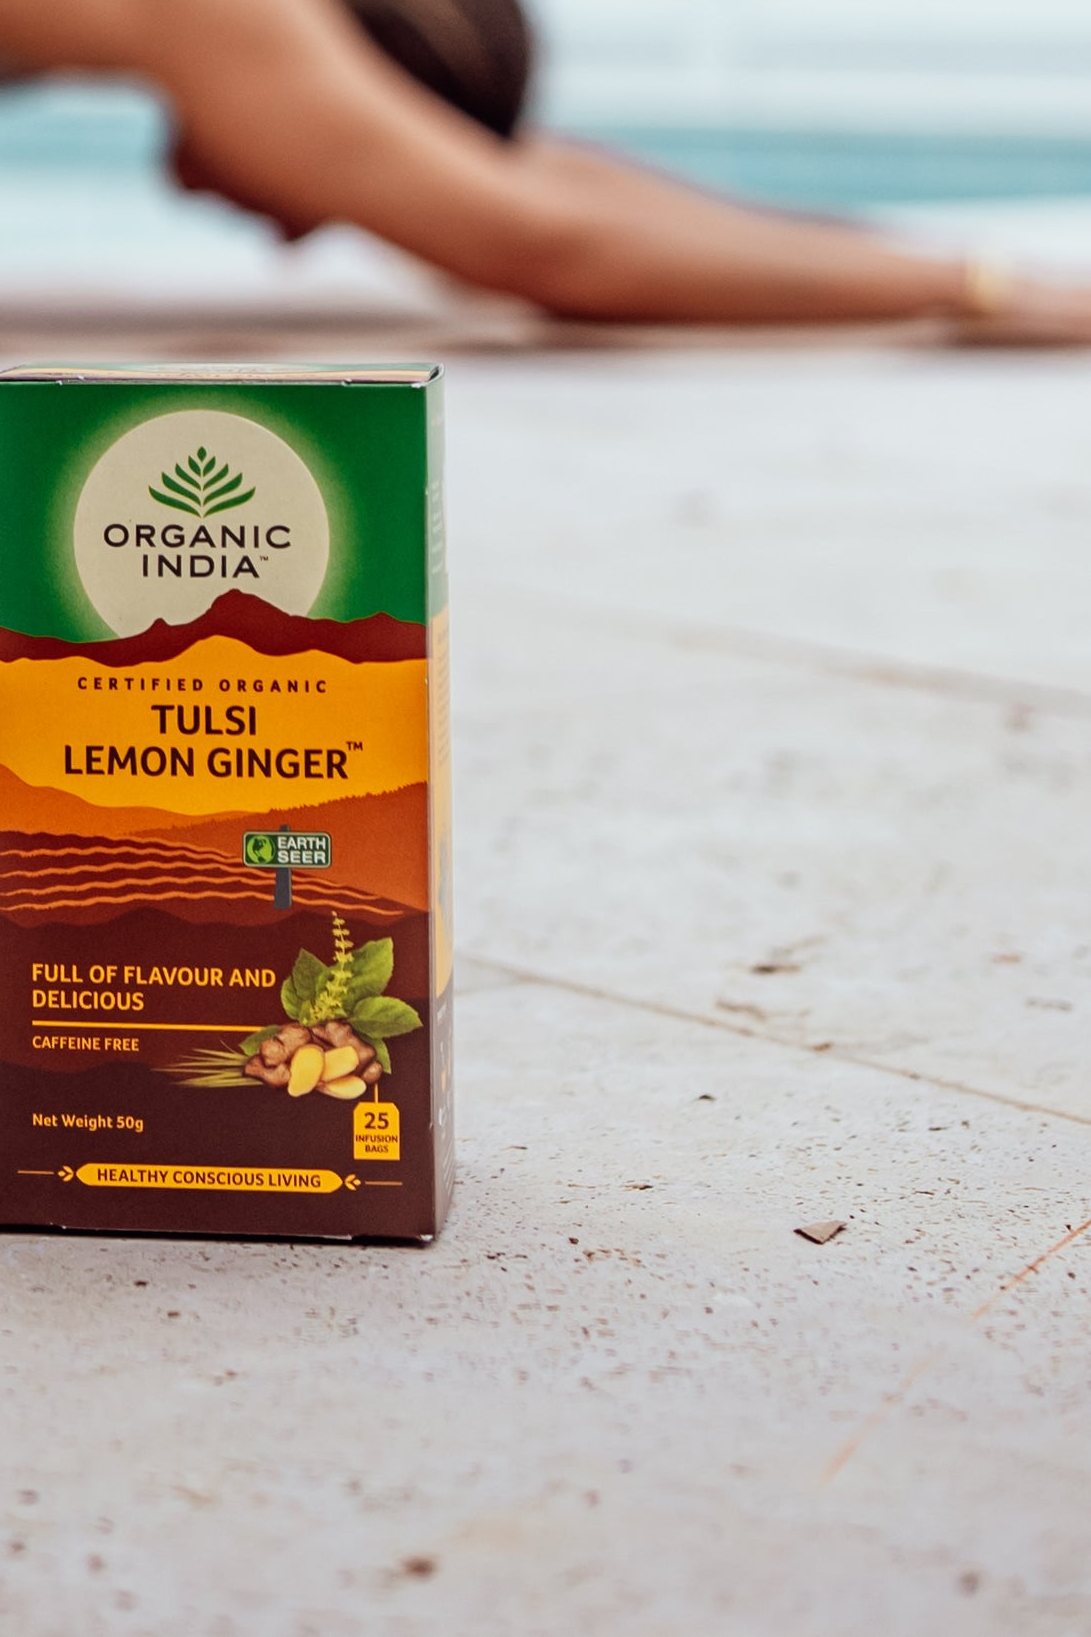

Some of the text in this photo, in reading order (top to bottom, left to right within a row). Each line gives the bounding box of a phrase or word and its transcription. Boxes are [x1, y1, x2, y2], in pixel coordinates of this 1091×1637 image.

[103, 524, 291, 549] ORGANIC
[77, 677, 327, 693] CERTIFIED ORGANIC
[151, 704, 257, 735] TULSI
[64, 745, 195, 776] LEMON
[277, 836, 326, 850] EARTH
[277, 850, 326, 864] SEER
[32, 963, 276, 988] FULL OF FLAVOUR AND
[32, 990, 144, 1011] DELICIOUS
[32, 1035, 140, 1052] CAFFEINE FREE
[32, 1113, 144, 1133] Net Weight 50g
[364, 1112, 389, 1130] 25
[355, 1134, 398, 1143] INFUSION
[365, 1144, 389, 1153] BAGS
[97, 1168, 321, 1188] HEALTHY CONSCIOUS LIVING
